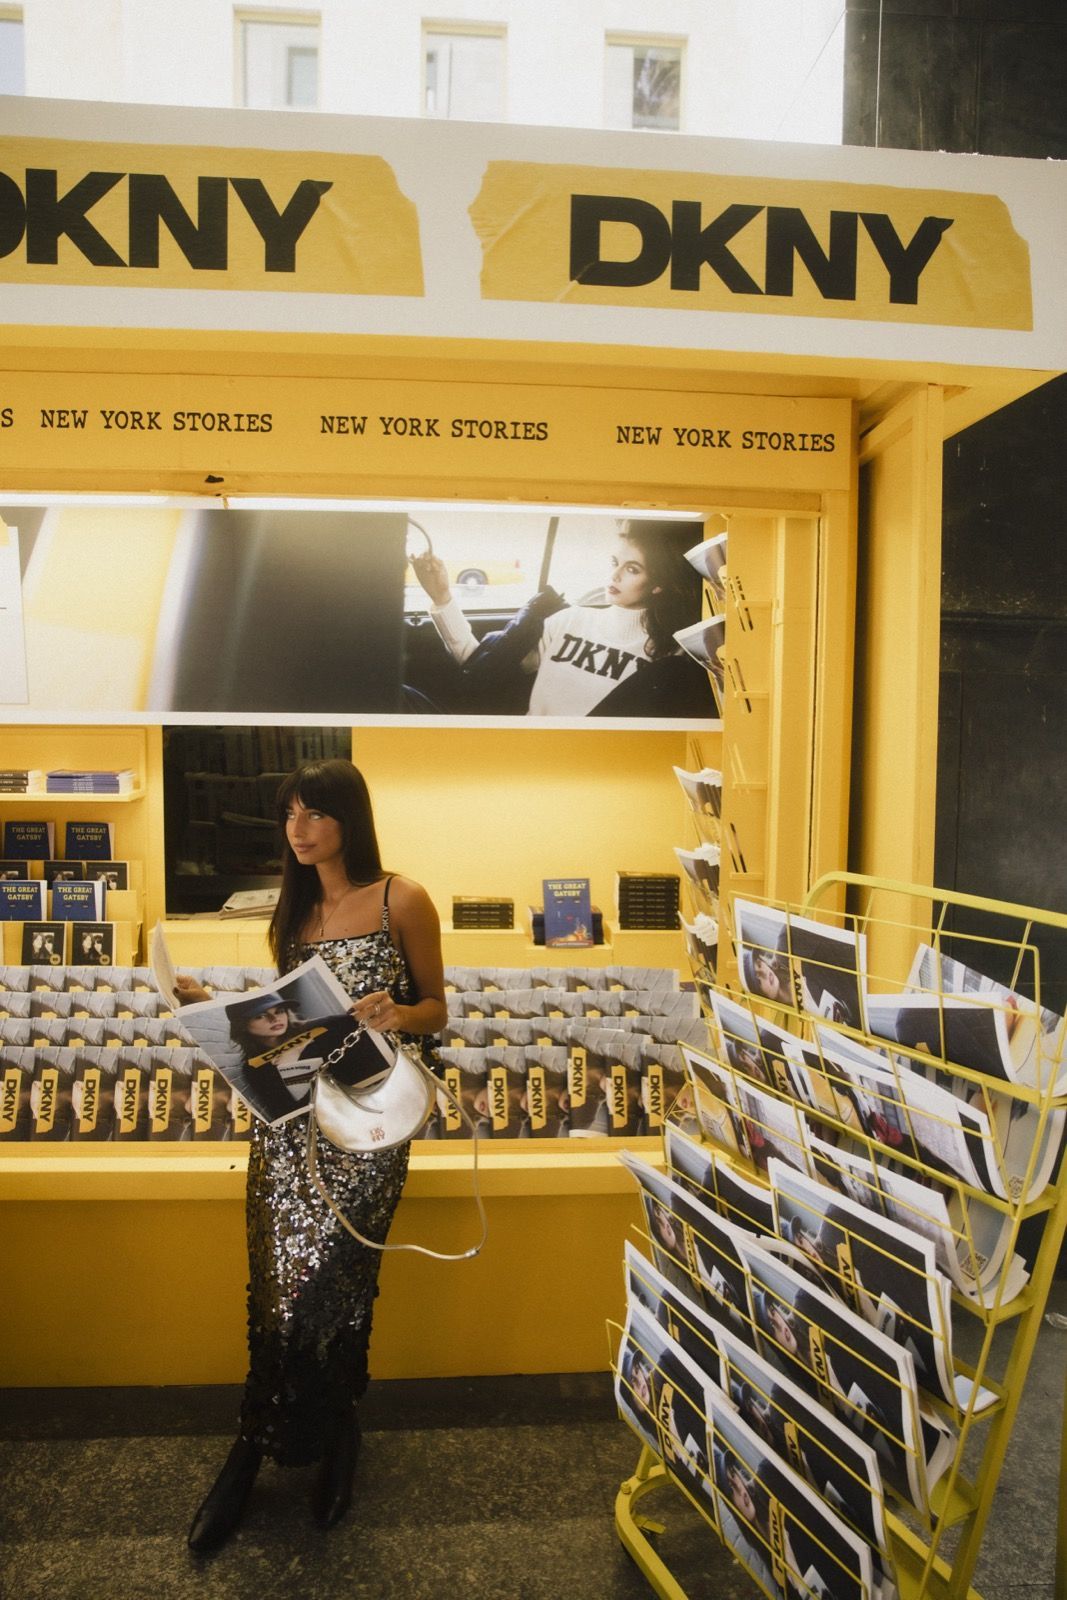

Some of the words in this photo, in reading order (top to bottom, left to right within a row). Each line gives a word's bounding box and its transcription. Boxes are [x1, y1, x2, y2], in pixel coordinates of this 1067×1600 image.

[0, 168, 334, 273] KNY
[569, 193, 956, 306] DKNY
[41, 409, 89, 429] NEW
[100, 410, 162, 431] YORK
[173, 411, 273, 433] STORIES
[320, 415, 368, 435] NEW
[379, 416, 441, 437] YORK
[451, 419, 549, 441] STORIES
[616, 426, 662, 446] NEW
[673, 427, 732, 449] YORK
[741, 431, 836, 453] STORIES
[71, 826, 86, 834] THE
[7, 893, 34, 901] GATSBY
[63, 893, 89, 901] GATSBY
[73, 886, 93, 894] GREAT
[493, 1077, 505, 1119] DKNY
[531, 1076, 543, 1118] DKNY
[571, 1056, 583, 1098] DKNY
[613, 1075, 625, 1118] DKNY
[650, 1074, 662, 1117] DKNY
[2, 1078, 17, 1123] DKNY
[39, 1078, 54, 1123] DKNY
[82, 1078, 97, 1123] DKNY
[123, 1078, 137, 1123] DKNY
[154, 1078, 169, 1123] DKNY
[197, 1078, 210, 1123] DKNY
